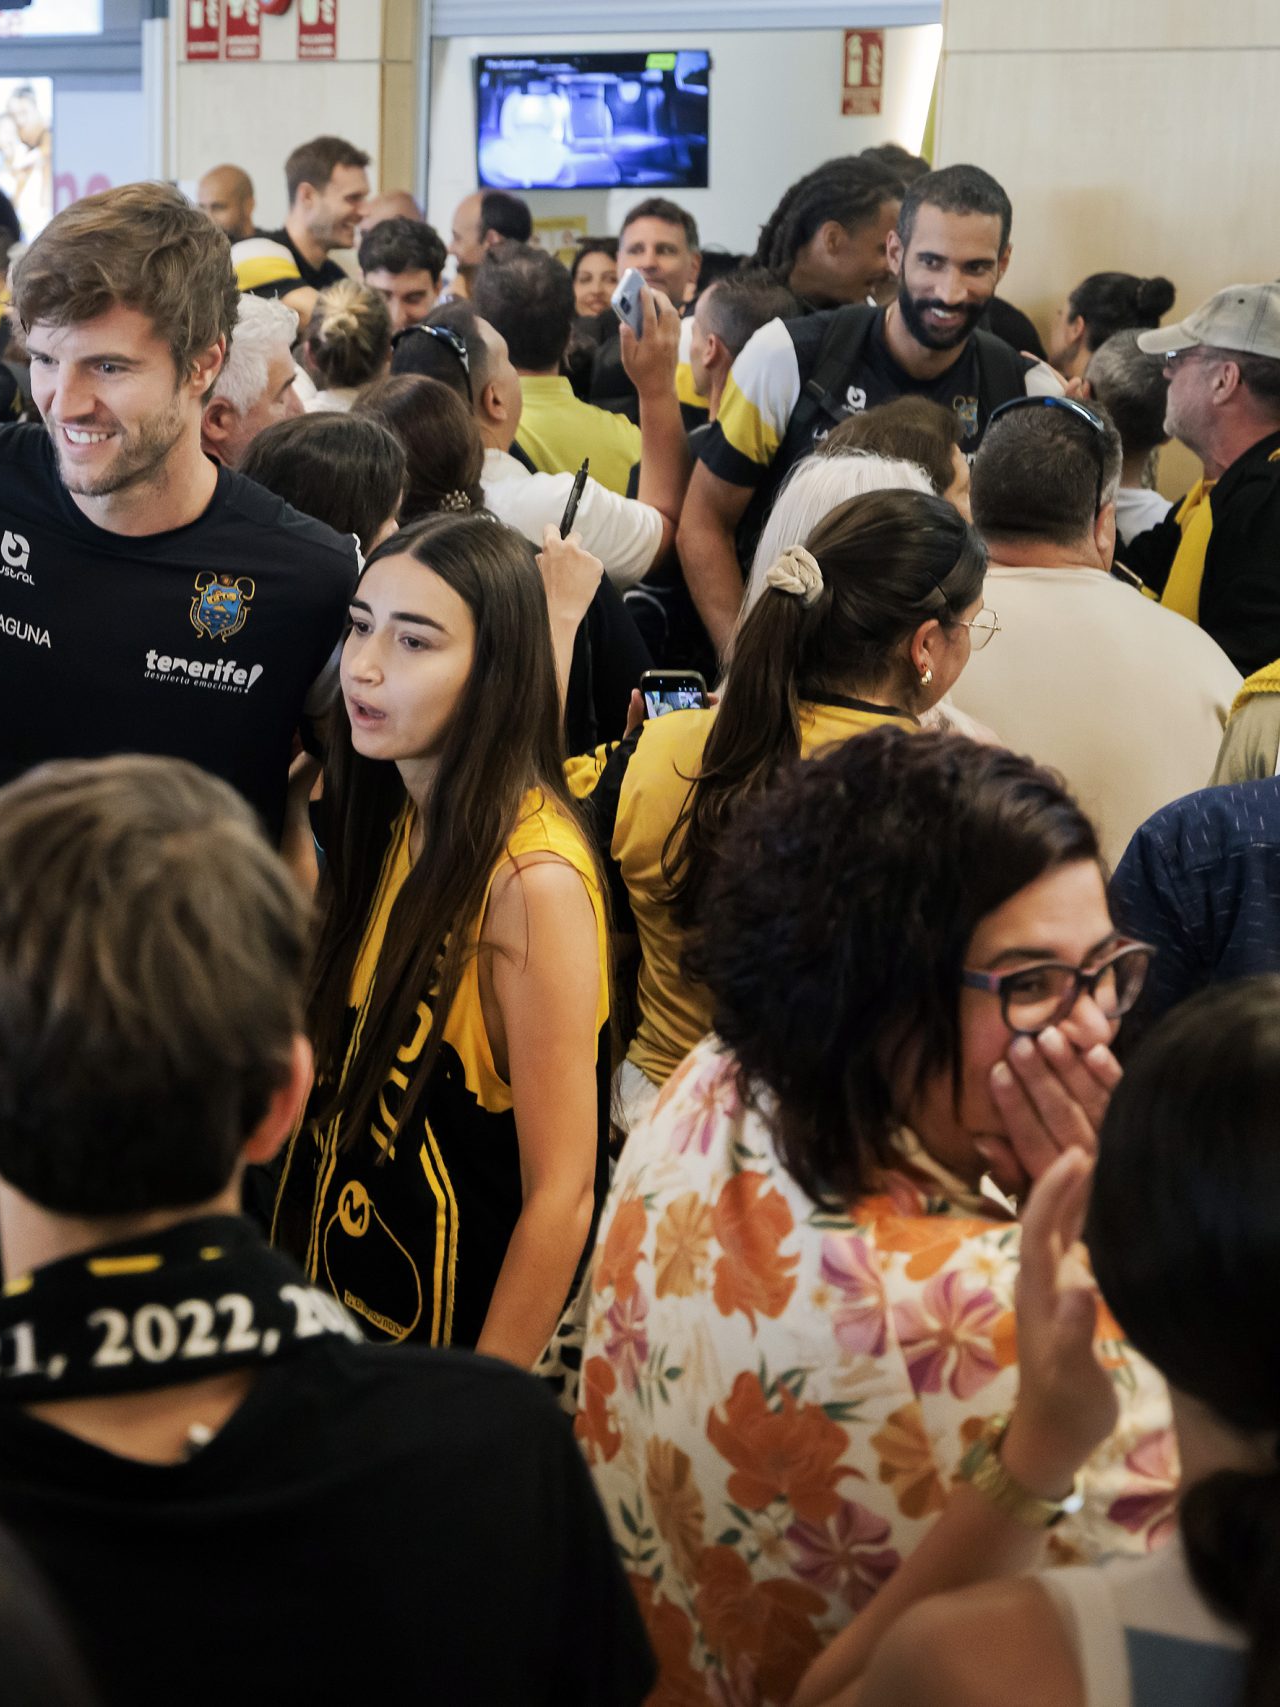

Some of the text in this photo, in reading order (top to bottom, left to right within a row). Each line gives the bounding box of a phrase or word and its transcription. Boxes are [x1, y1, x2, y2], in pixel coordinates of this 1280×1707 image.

[144, 669, 244, 694] despierta emociones
[146, 649, 264, 694] tenerife!
[87, 1294, 281, 1368] 2022,
